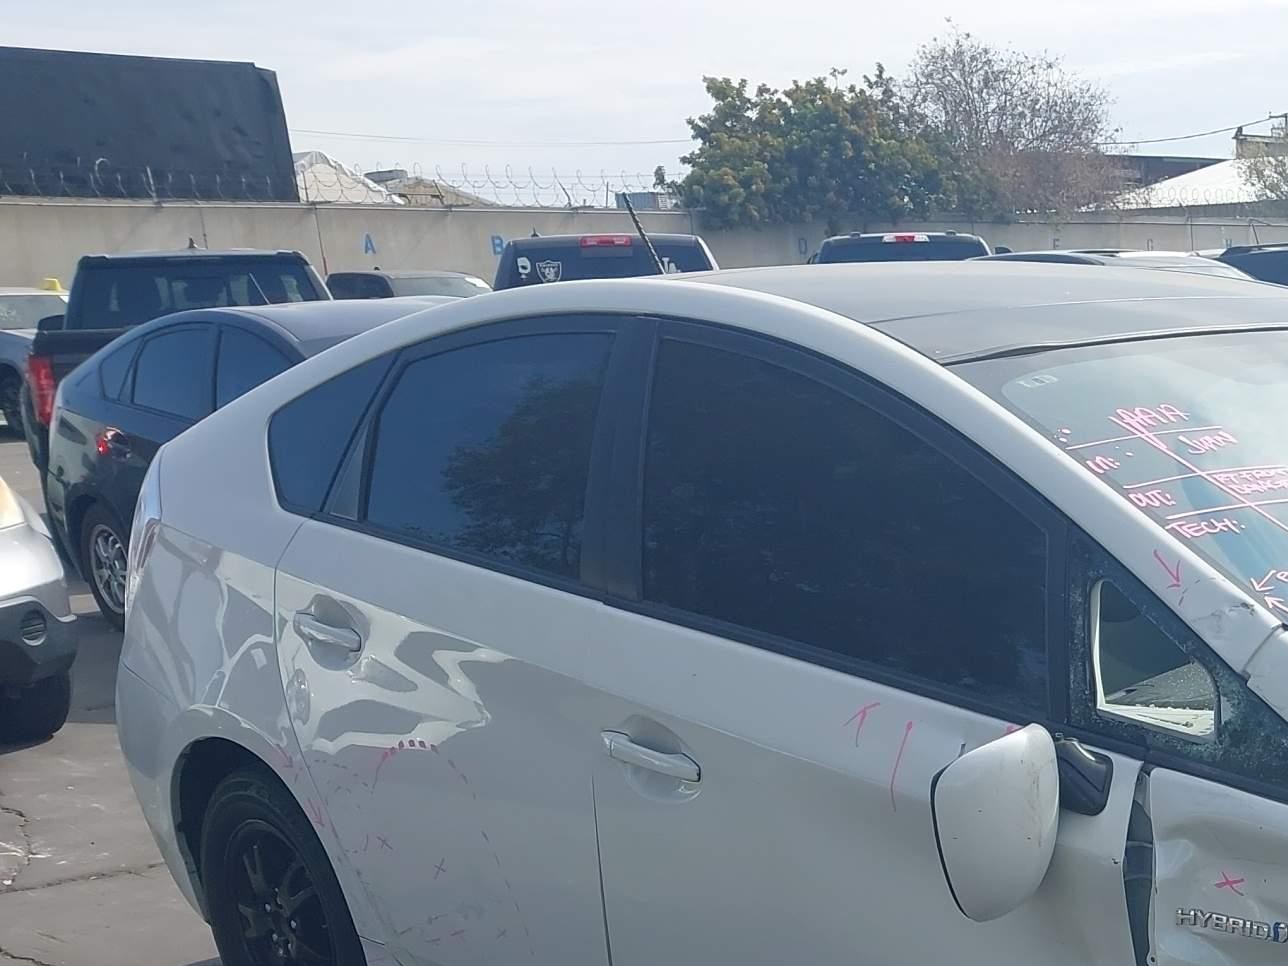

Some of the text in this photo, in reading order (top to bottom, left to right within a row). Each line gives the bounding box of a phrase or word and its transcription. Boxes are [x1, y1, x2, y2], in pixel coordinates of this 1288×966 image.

[364, 233, 377, 254] A
[1165, 517, 1245, 540] TECH:
[1176, 908, 1271, 941] HYBRID
